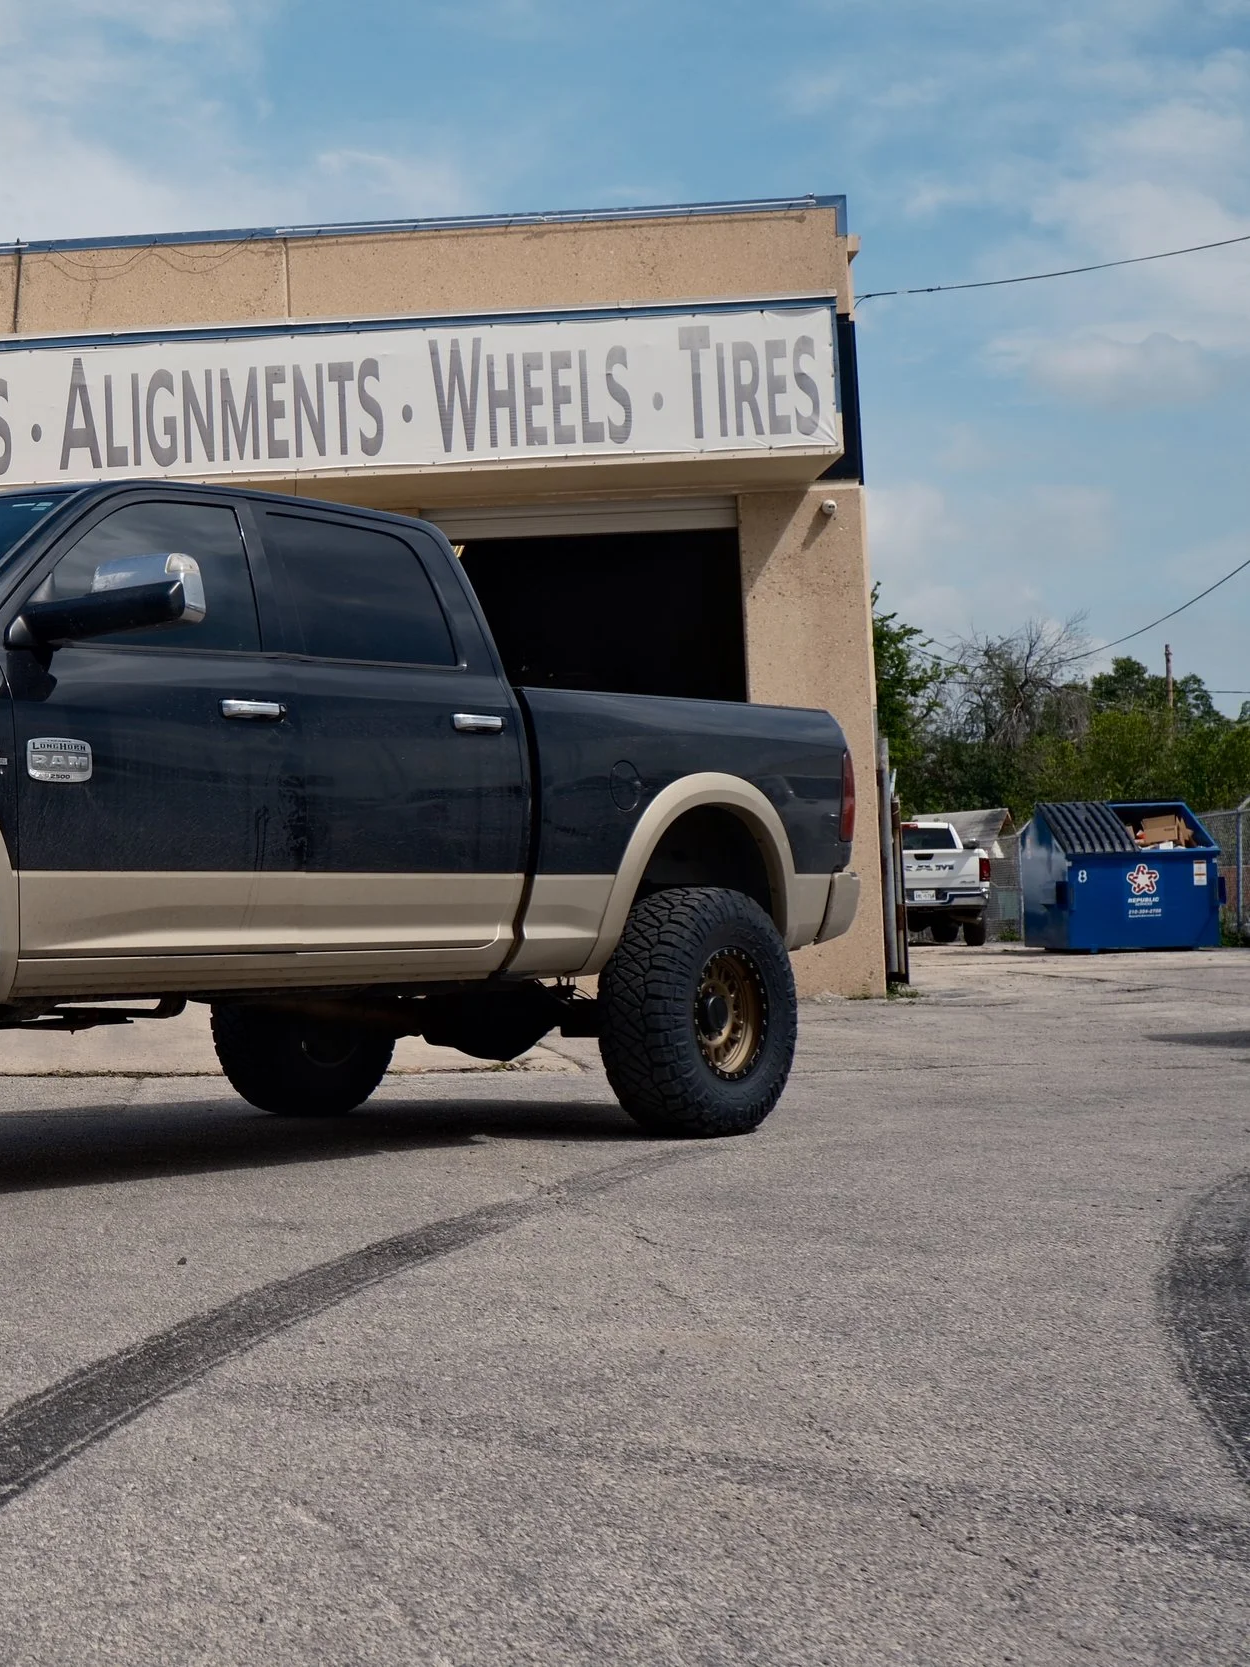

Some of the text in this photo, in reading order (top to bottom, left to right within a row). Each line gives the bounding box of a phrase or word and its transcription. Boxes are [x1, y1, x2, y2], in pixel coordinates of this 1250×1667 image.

[59, 356, 385, 470] ALIGNMENTS
[428, 336, 633, 453] WHEELS
[678, 324, 821, 439] TIRES
[31, 754, 88, 770] RAM
[1078, 869, 1087, 883] 8
